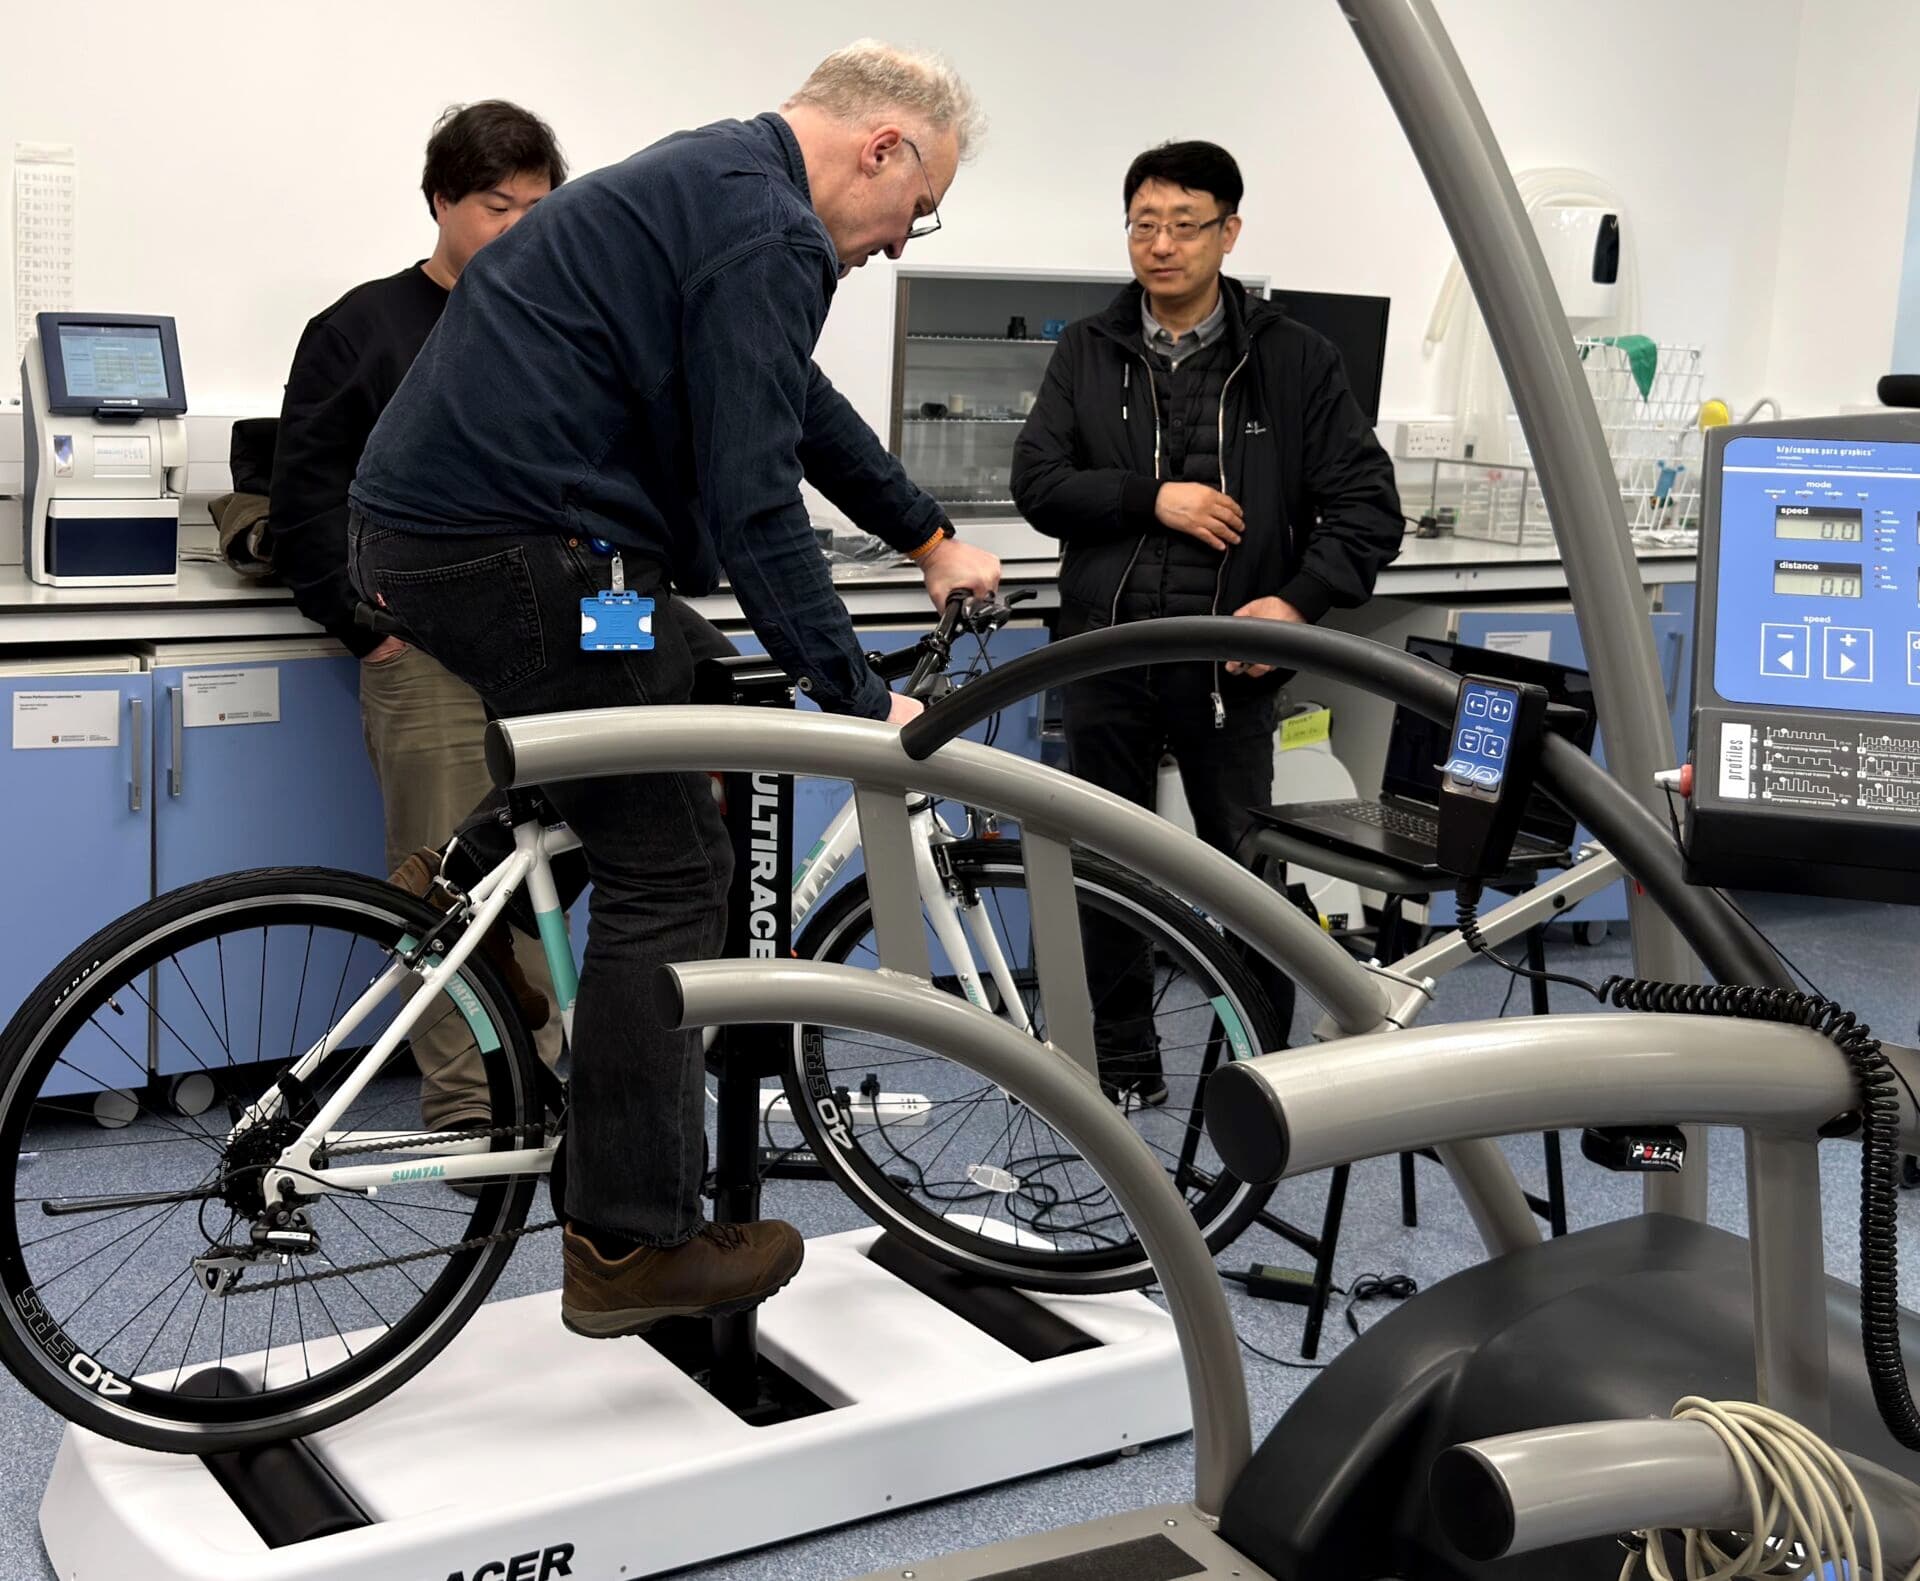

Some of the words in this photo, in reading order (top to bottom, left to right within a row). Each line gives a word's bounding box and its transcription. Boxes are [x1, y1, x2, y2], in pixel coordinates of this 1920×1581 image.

[1806, 481, 1832, 489] mode
[1780, 507, 1809, 515] speed
[1821, 521, 1855, 540] 0.0
[1779, 561, 1819, 571] distance
[1820, 577, 1855, 596] 0.0
[1803, 615, 1831, 624] speed
[1726, 740, 1745, 781] profiles
[54, 960, 100, 1006] KENDA
[1632, 1143, 1683, 1168] POLAR
[390, 1165, 447, 1182] SUMTAL
